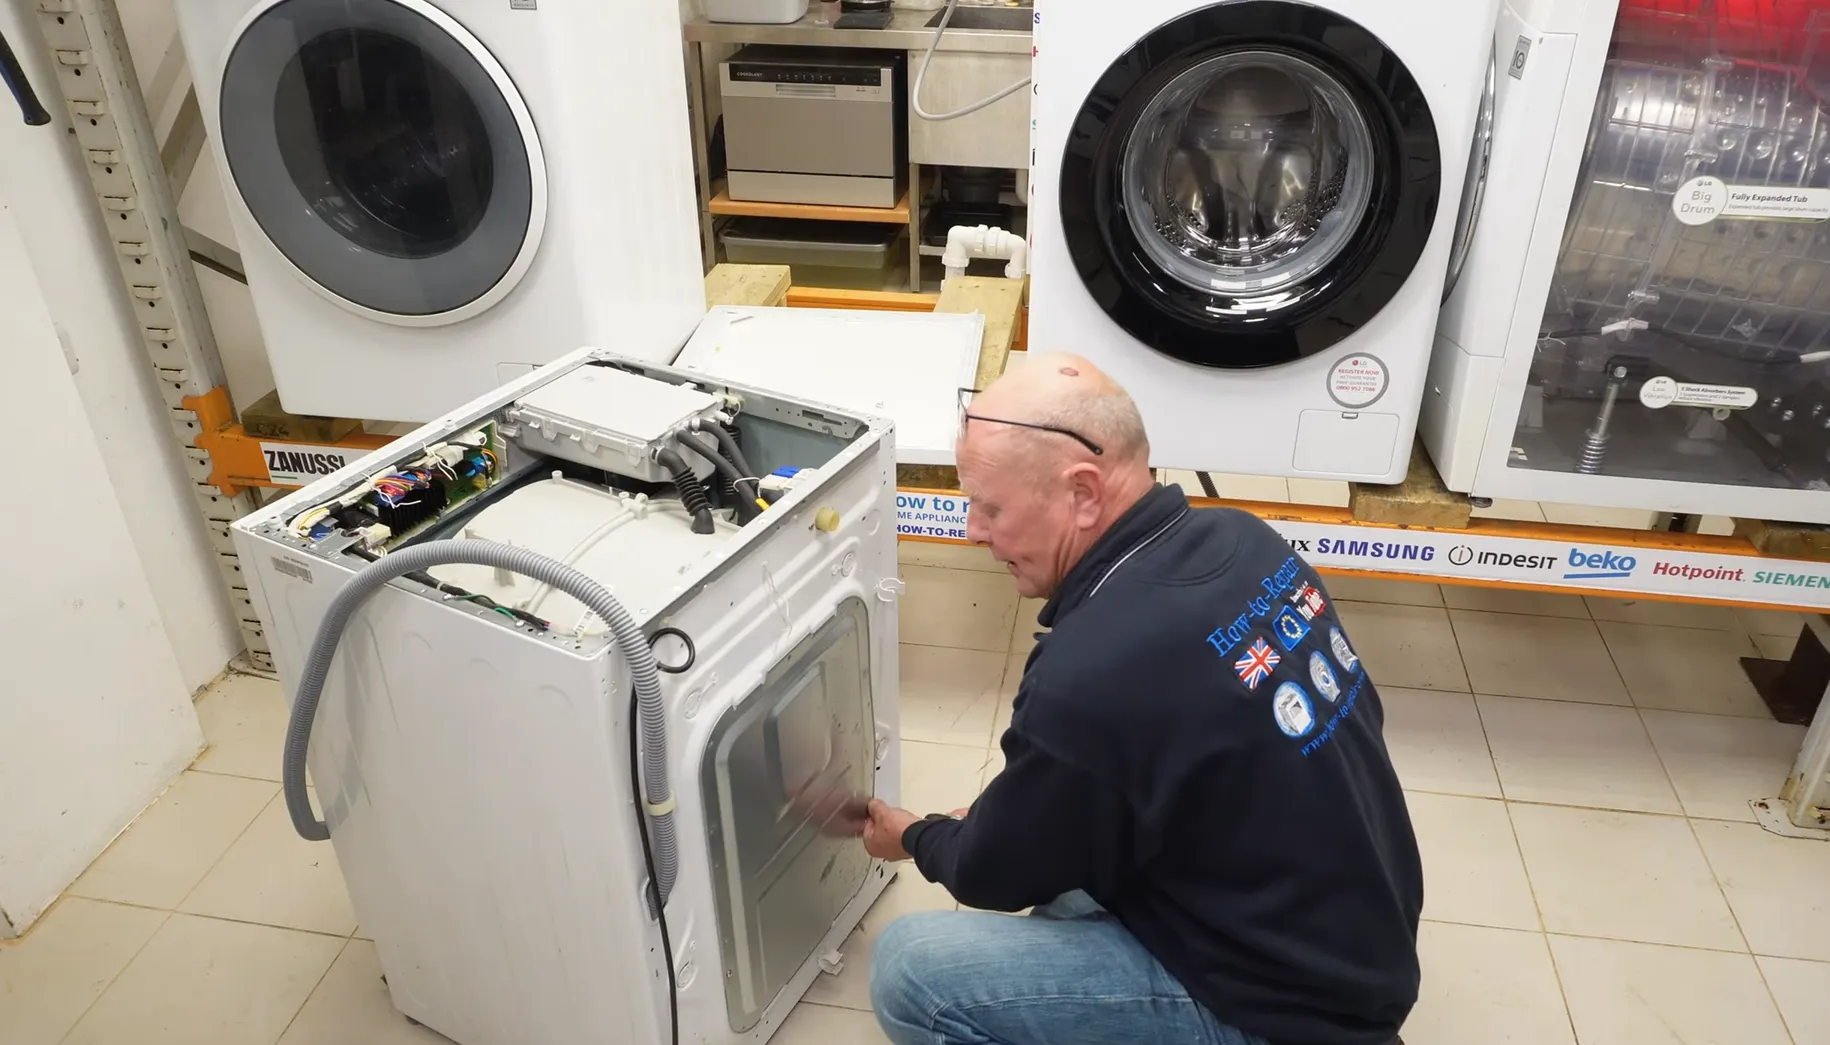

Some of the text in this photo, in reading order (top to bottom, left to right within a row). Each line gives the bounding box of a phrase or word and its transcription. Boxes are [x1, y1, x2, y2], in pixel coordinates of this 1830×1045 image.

[1691, 191, 1712, 203] Big
[1731, 193, 1751, 202] Fully
[1752, 194, 1792, 203] Expanded
[1680, 203, 1715, 214] Drum
[263, 450, 346, 475] ZANUSSI
[932, 496, 955, 512] to
[1317, 538, 1435, 561] SAMSUNG
[1477, 551, 1558, 570] INDESIT
[1568, 548, 1637, 571] beko
[1206, 556, 1300, 657] How-to-Repair
